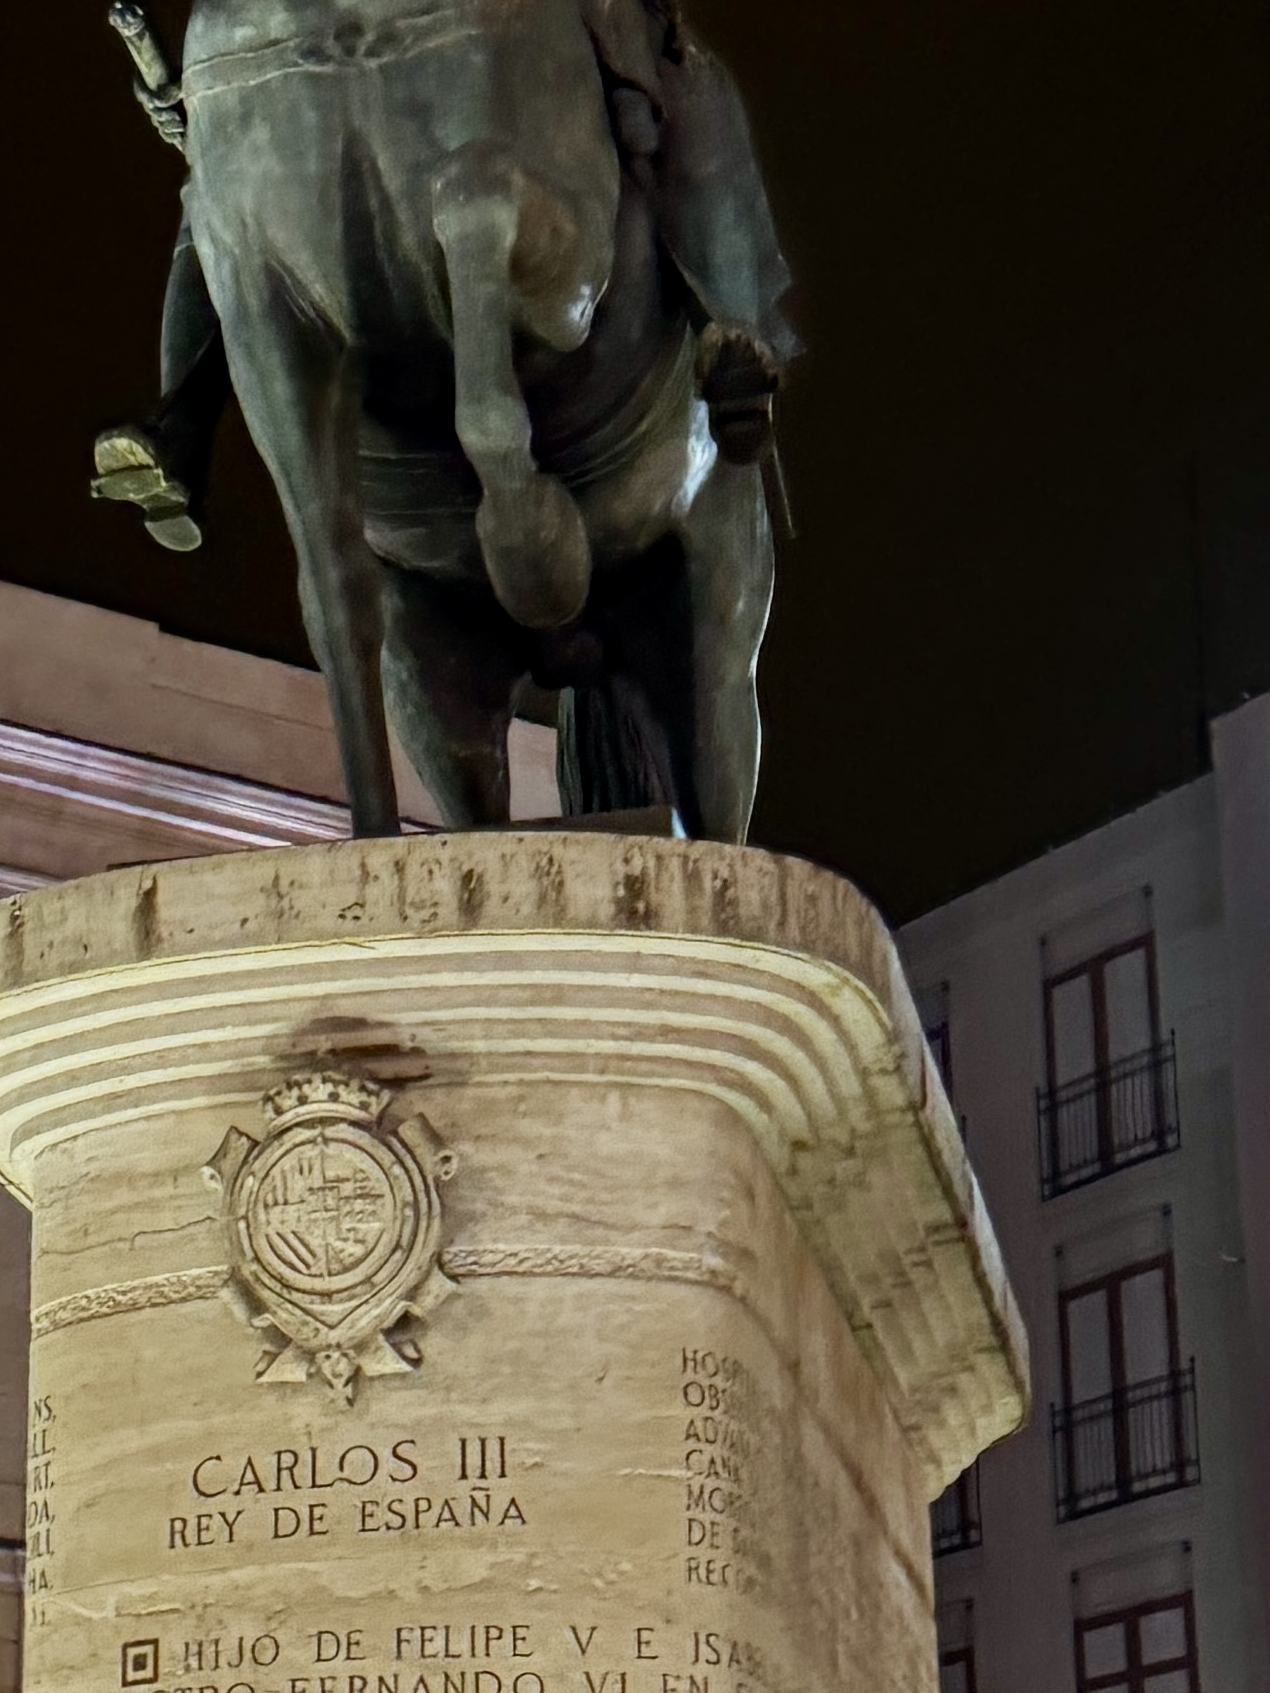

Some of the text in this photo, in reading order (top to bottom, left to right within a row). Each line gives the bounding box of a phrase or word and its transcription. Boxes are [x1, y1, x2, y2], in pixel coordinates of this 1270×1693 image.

[191, 1435, 510, 1500] CARLOS III
[168, 1485, 530, 1550] REY DE ESPAÑA
[182, 1631, 282, 1671] HIJO
[312, 1628, 366, 1665] DE
[394, 1624, 534, 1661] FELIPE
[568, 1625, 599, 1659] V
[635, 1627, 659, 1660] E
